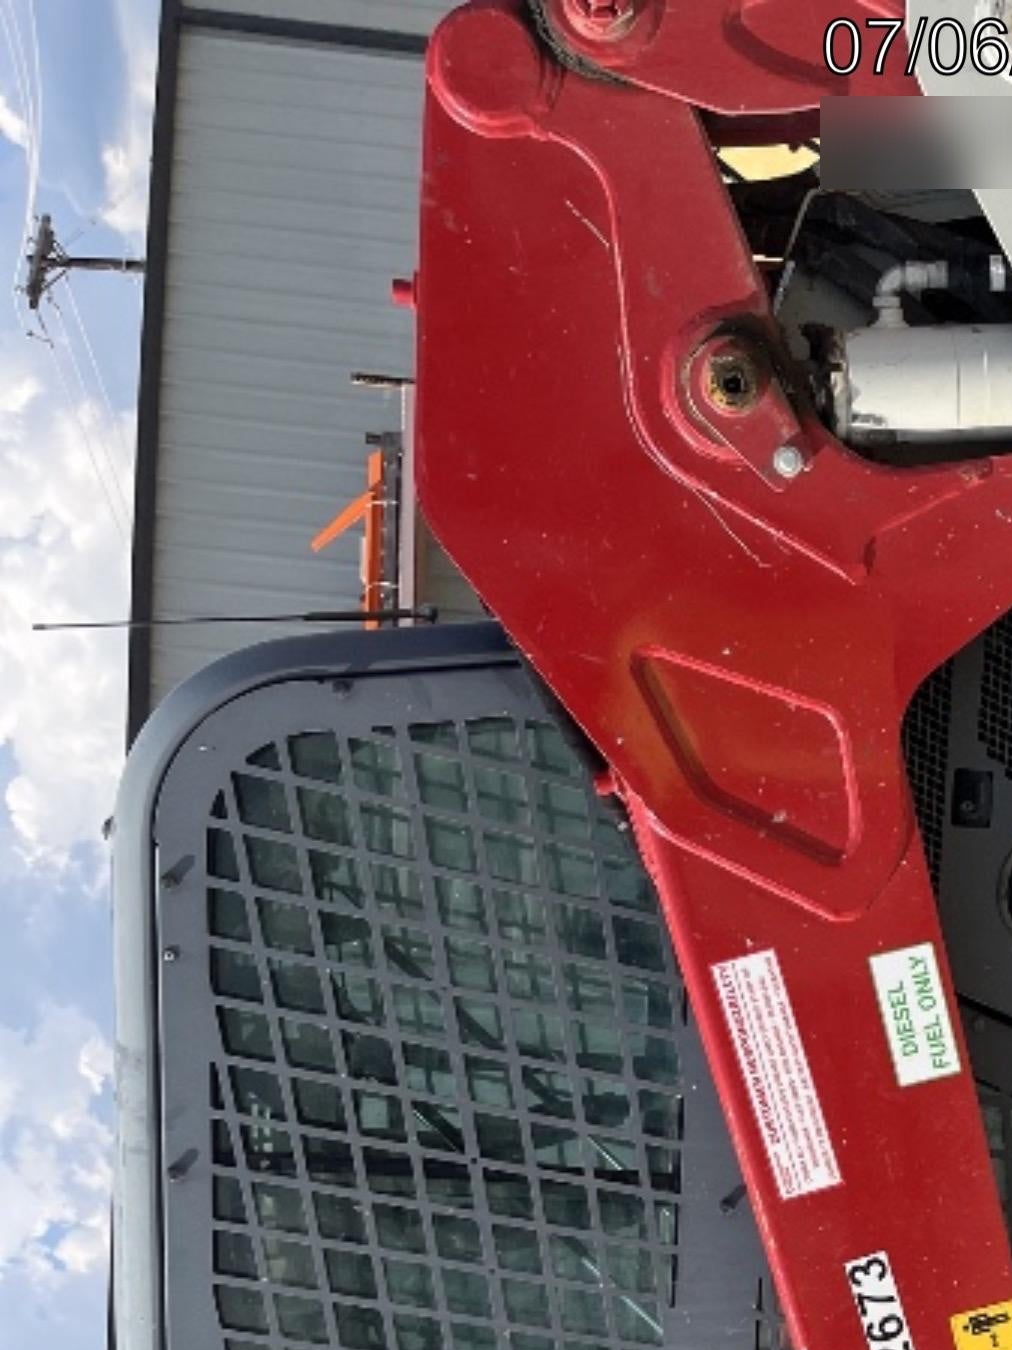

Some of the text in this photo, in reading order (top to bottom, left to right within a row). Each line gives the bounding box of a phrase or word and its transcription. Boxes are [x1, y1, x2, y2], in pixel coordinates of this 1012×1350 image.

[888, 980, 919, 1057] DIESEL
[908, 956, 951, 1069] FUEL ONLY
